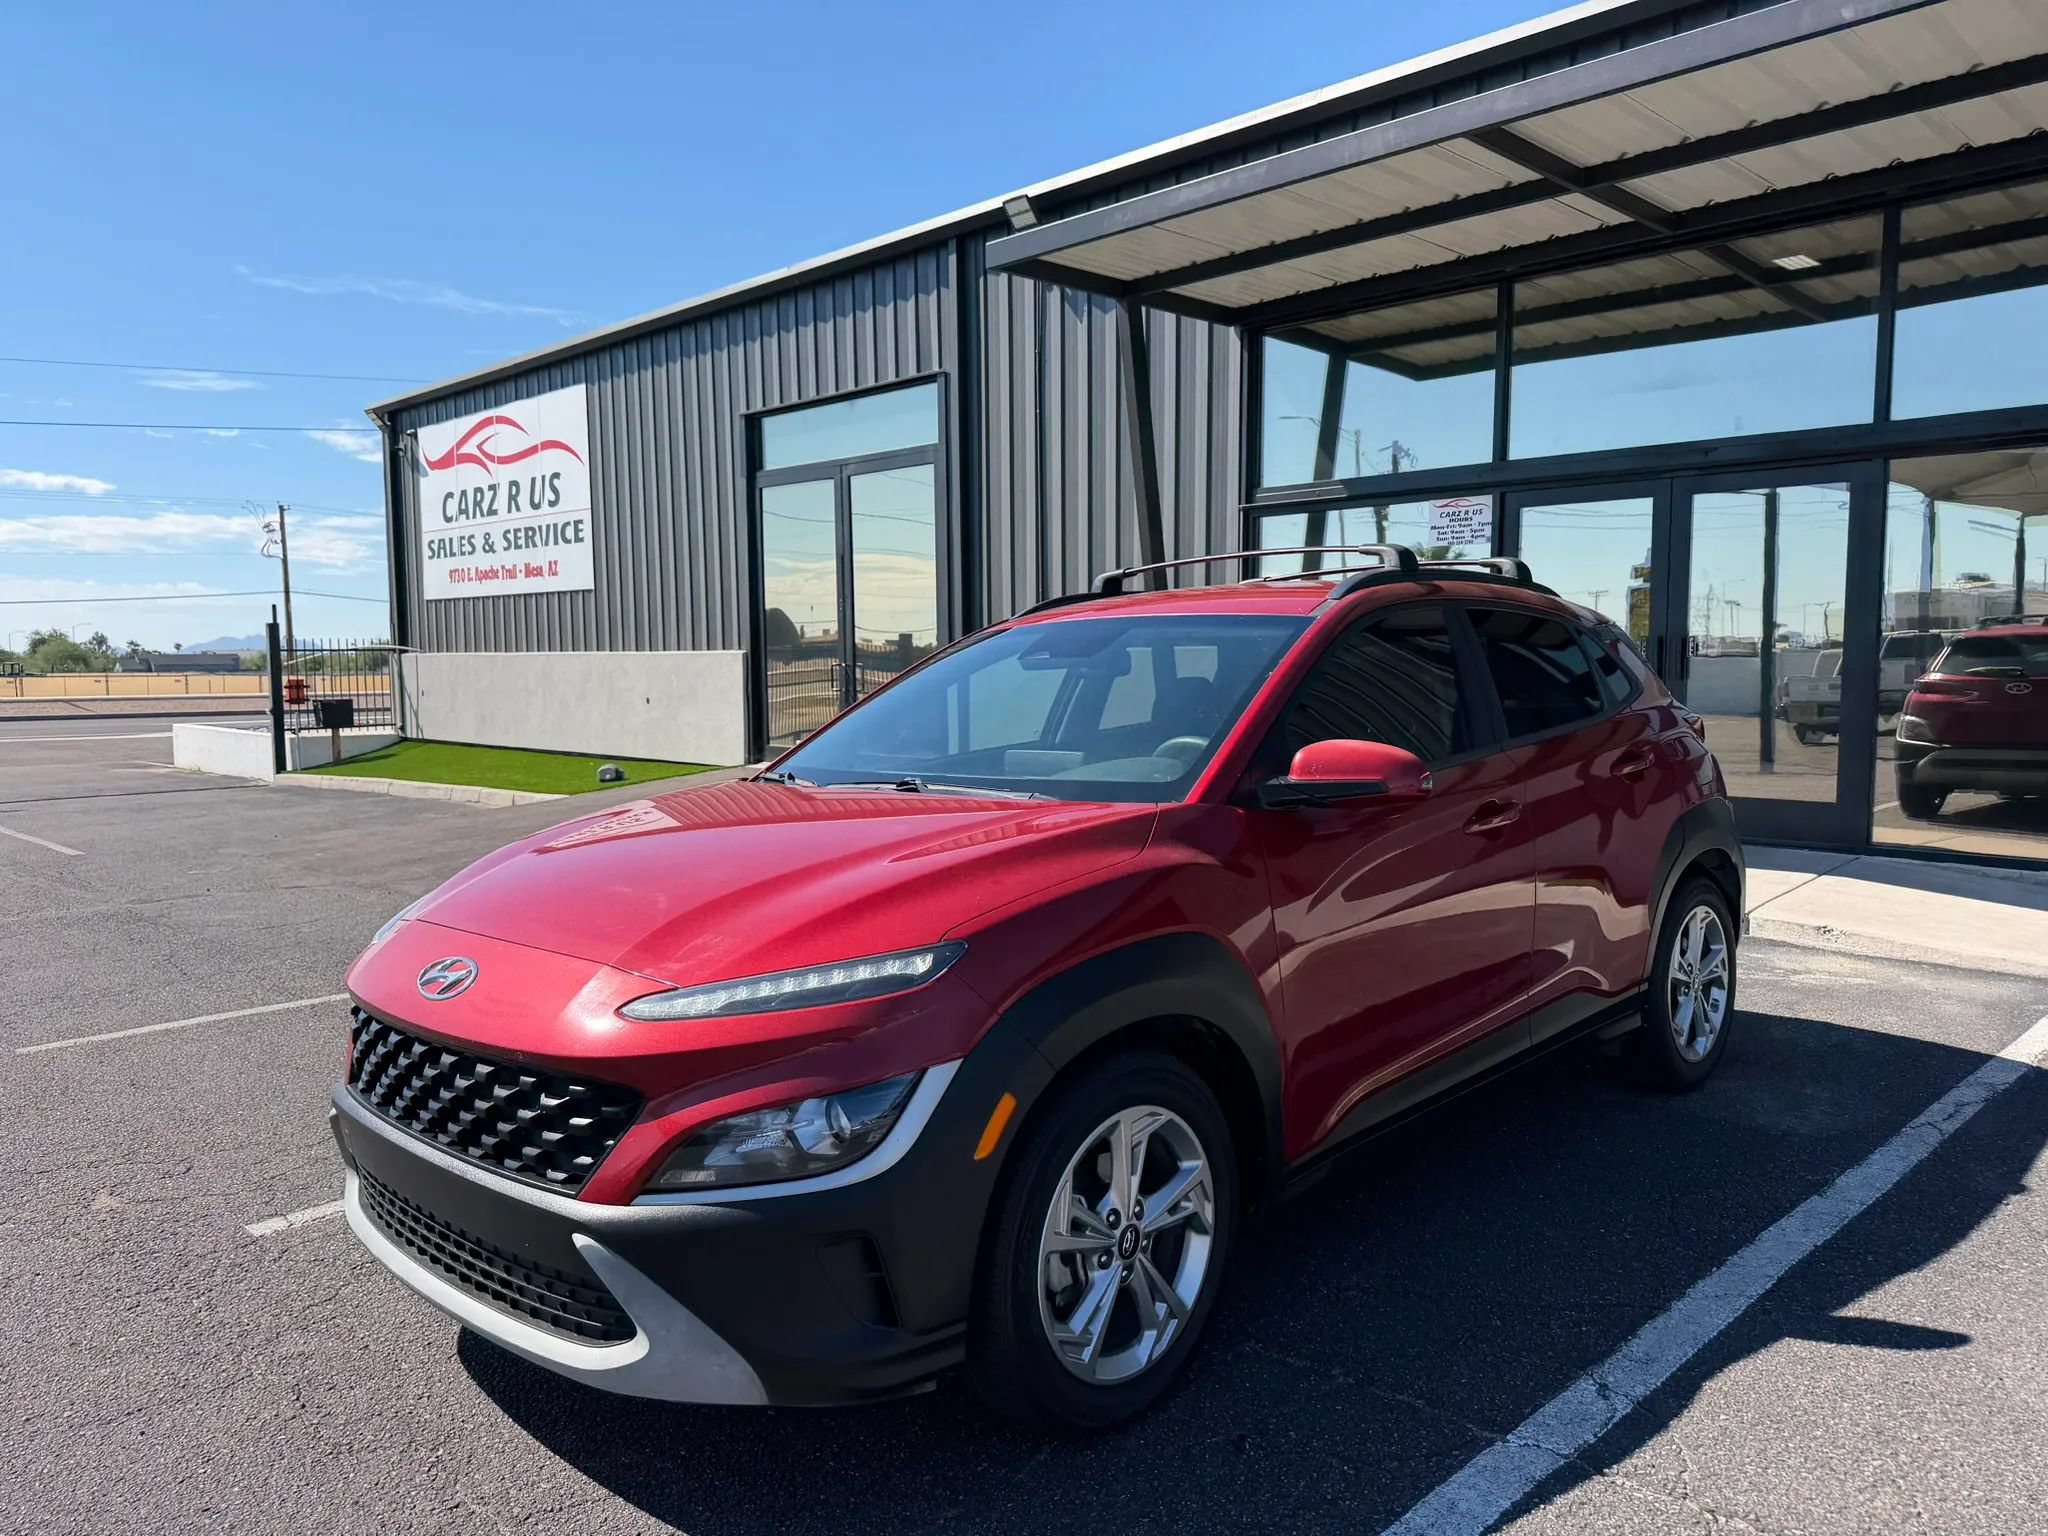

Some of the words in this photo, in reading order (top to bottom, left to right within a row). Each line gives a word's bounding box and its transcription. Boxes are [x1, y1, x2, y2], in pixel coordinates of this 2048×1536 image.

[442, 482, 498, 523] CARZ
[507, 479, 521, 513] R
[530, 472, 561, 511] US
[1440, 510, 1462, 518] CARZ
[428, 534, 476, 560] SALES
[482, 532, 496, 554] &
[503, 519, 585, 551] SERVICE
[475, 564, 500, 584] Apache
[501, 563, 518, 580] Trail
[548, 559, 559, 577] AZ
